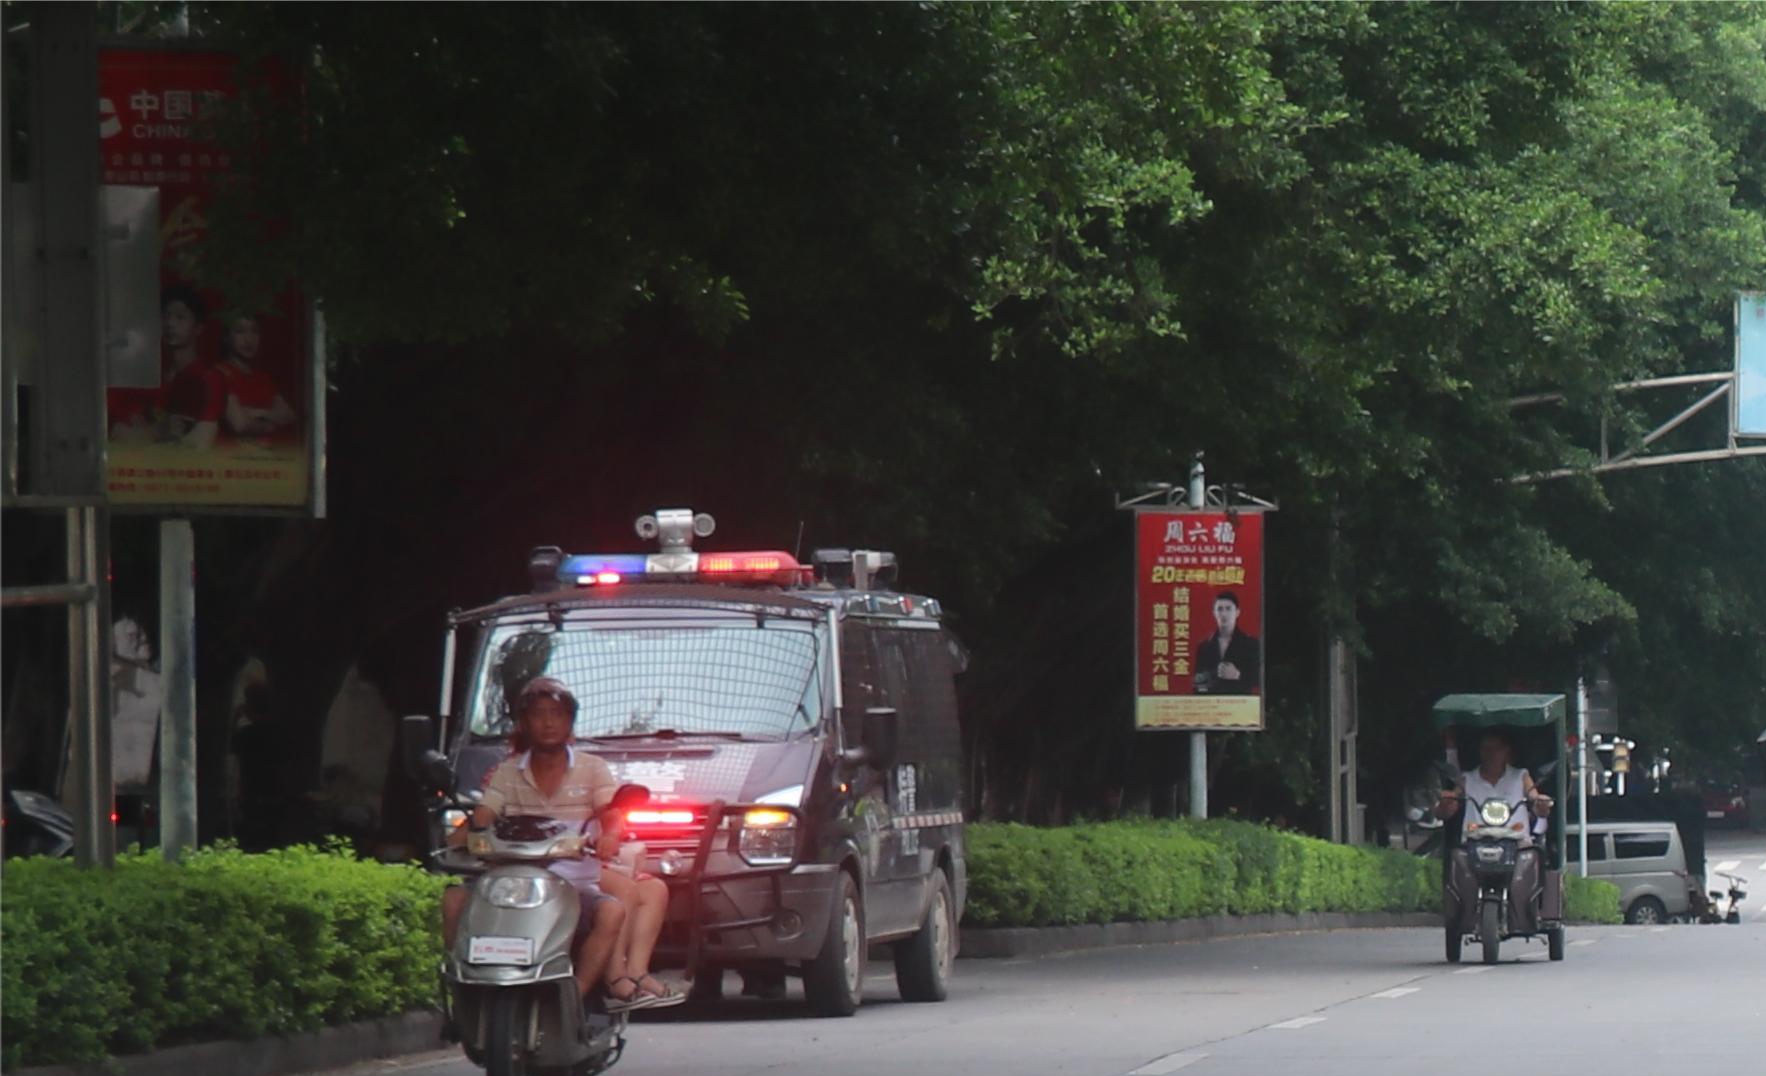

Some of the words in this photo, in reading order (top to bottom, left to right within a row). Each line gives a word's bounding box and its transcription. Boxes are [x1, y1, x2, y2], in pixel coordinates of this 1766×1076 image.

[1163, 520, 1237, 544] 周六福
[1165, 544, 1196, 554] ZHOU
[1198, 544, 1216, 554] LIU
[1218, 544, 1234, 554] FU
[1152, 602, 1169, 692] 首选周六福
[1173, 586, 1190, 676] 结婚买三金
